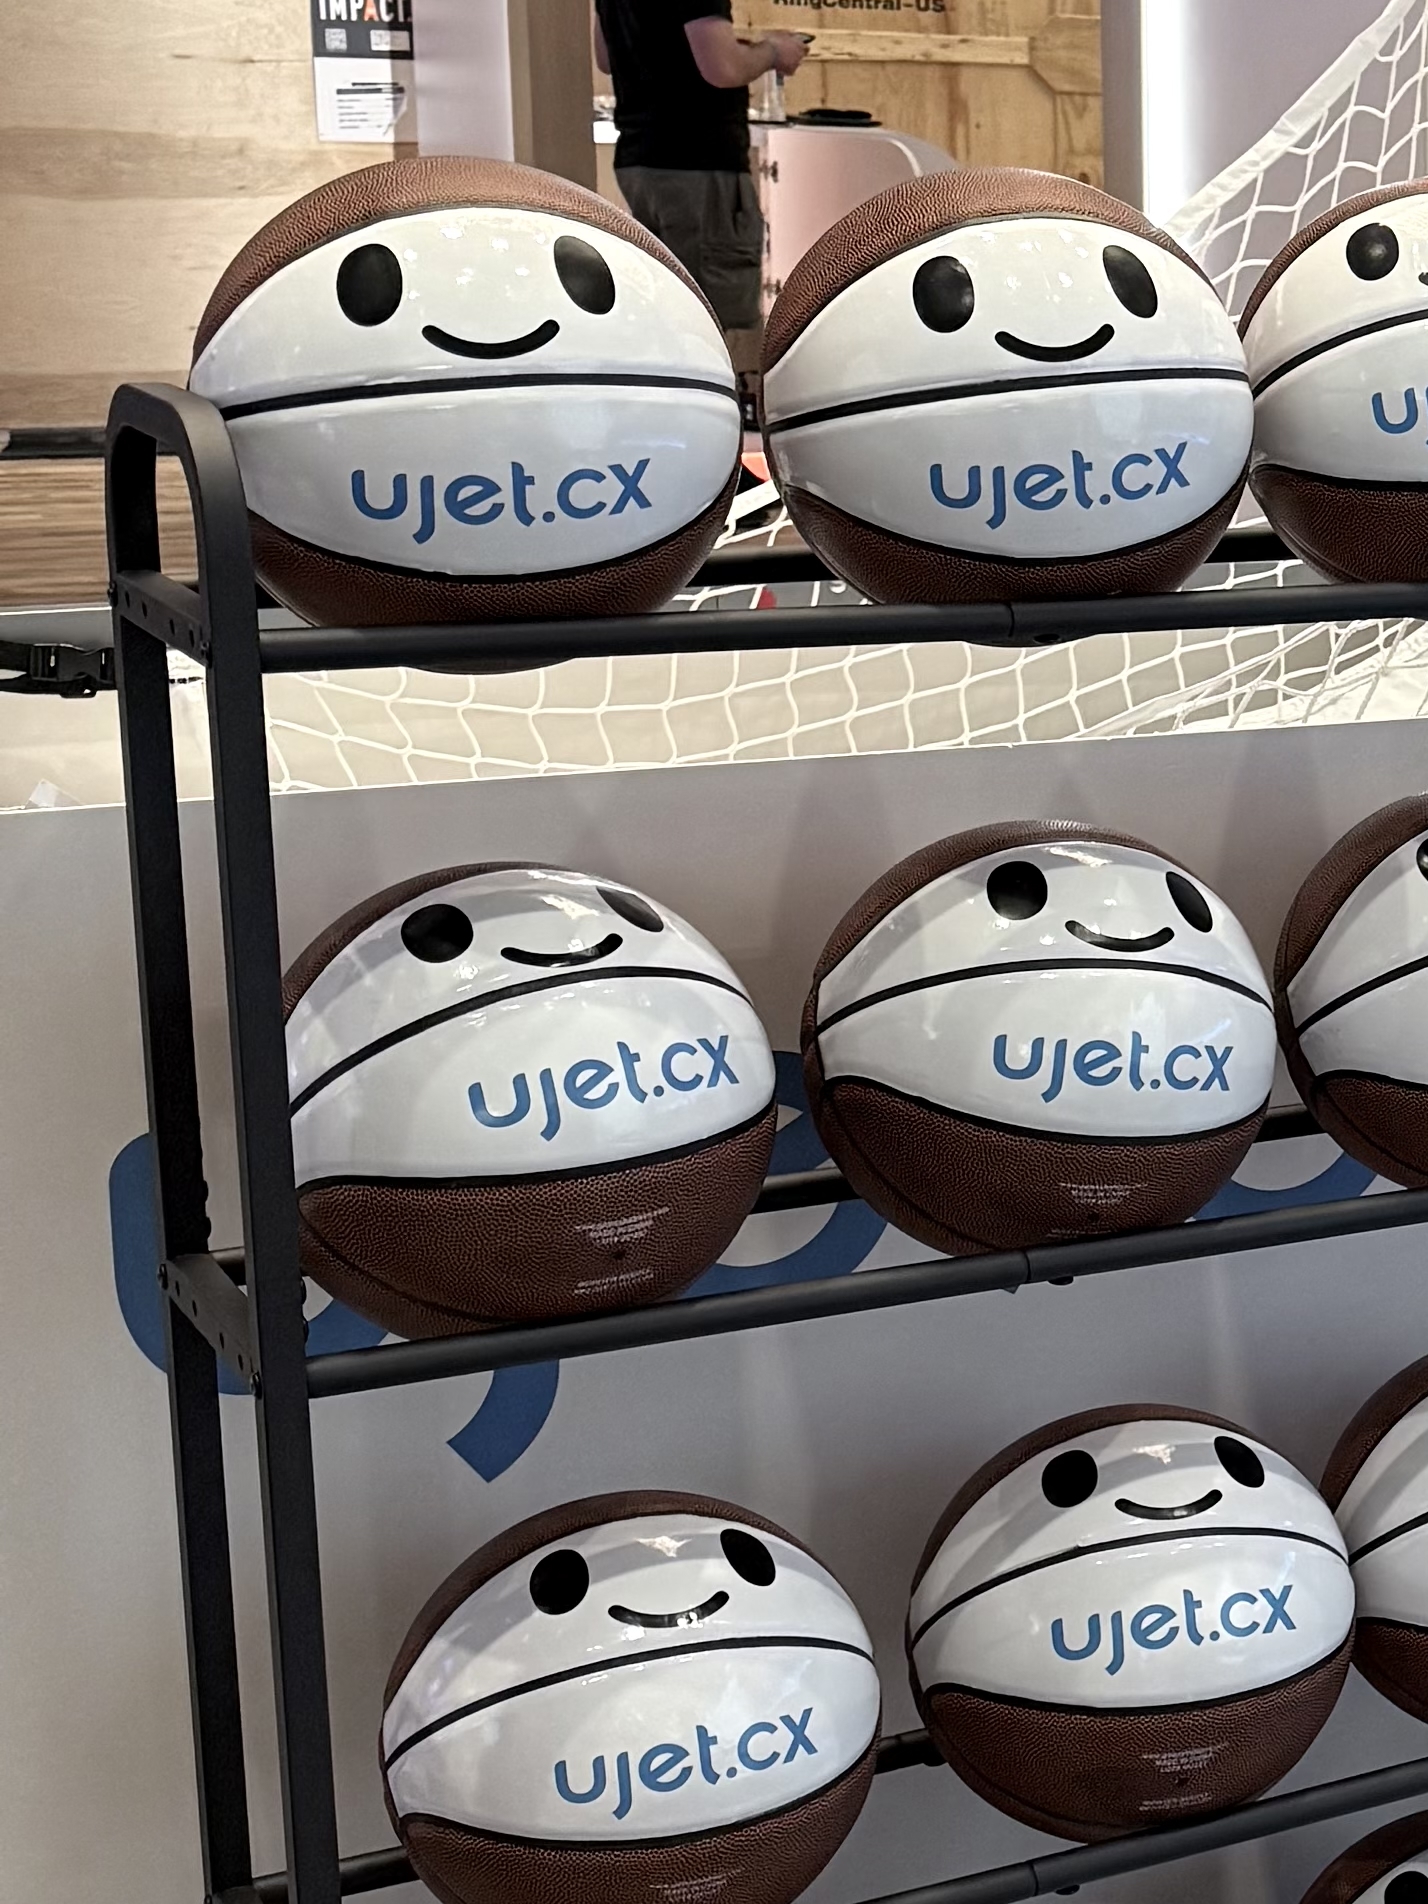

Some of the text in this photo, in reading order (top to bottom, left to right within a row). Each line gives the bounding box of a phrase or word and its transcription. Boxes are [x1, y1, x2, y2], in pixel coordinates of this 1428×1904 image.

[350, 458, 652, 544] ujet.cx
[930, 441, 1190, 530] ujet.cx
[467, 1034, 740, 1142] ujet.cx
[993, 1030, 1234, 1103] ujet.cx
[1050, 1583, 1297, 1676] ujet.cx
[554, 1707, 819, 1821] ujet.cx
